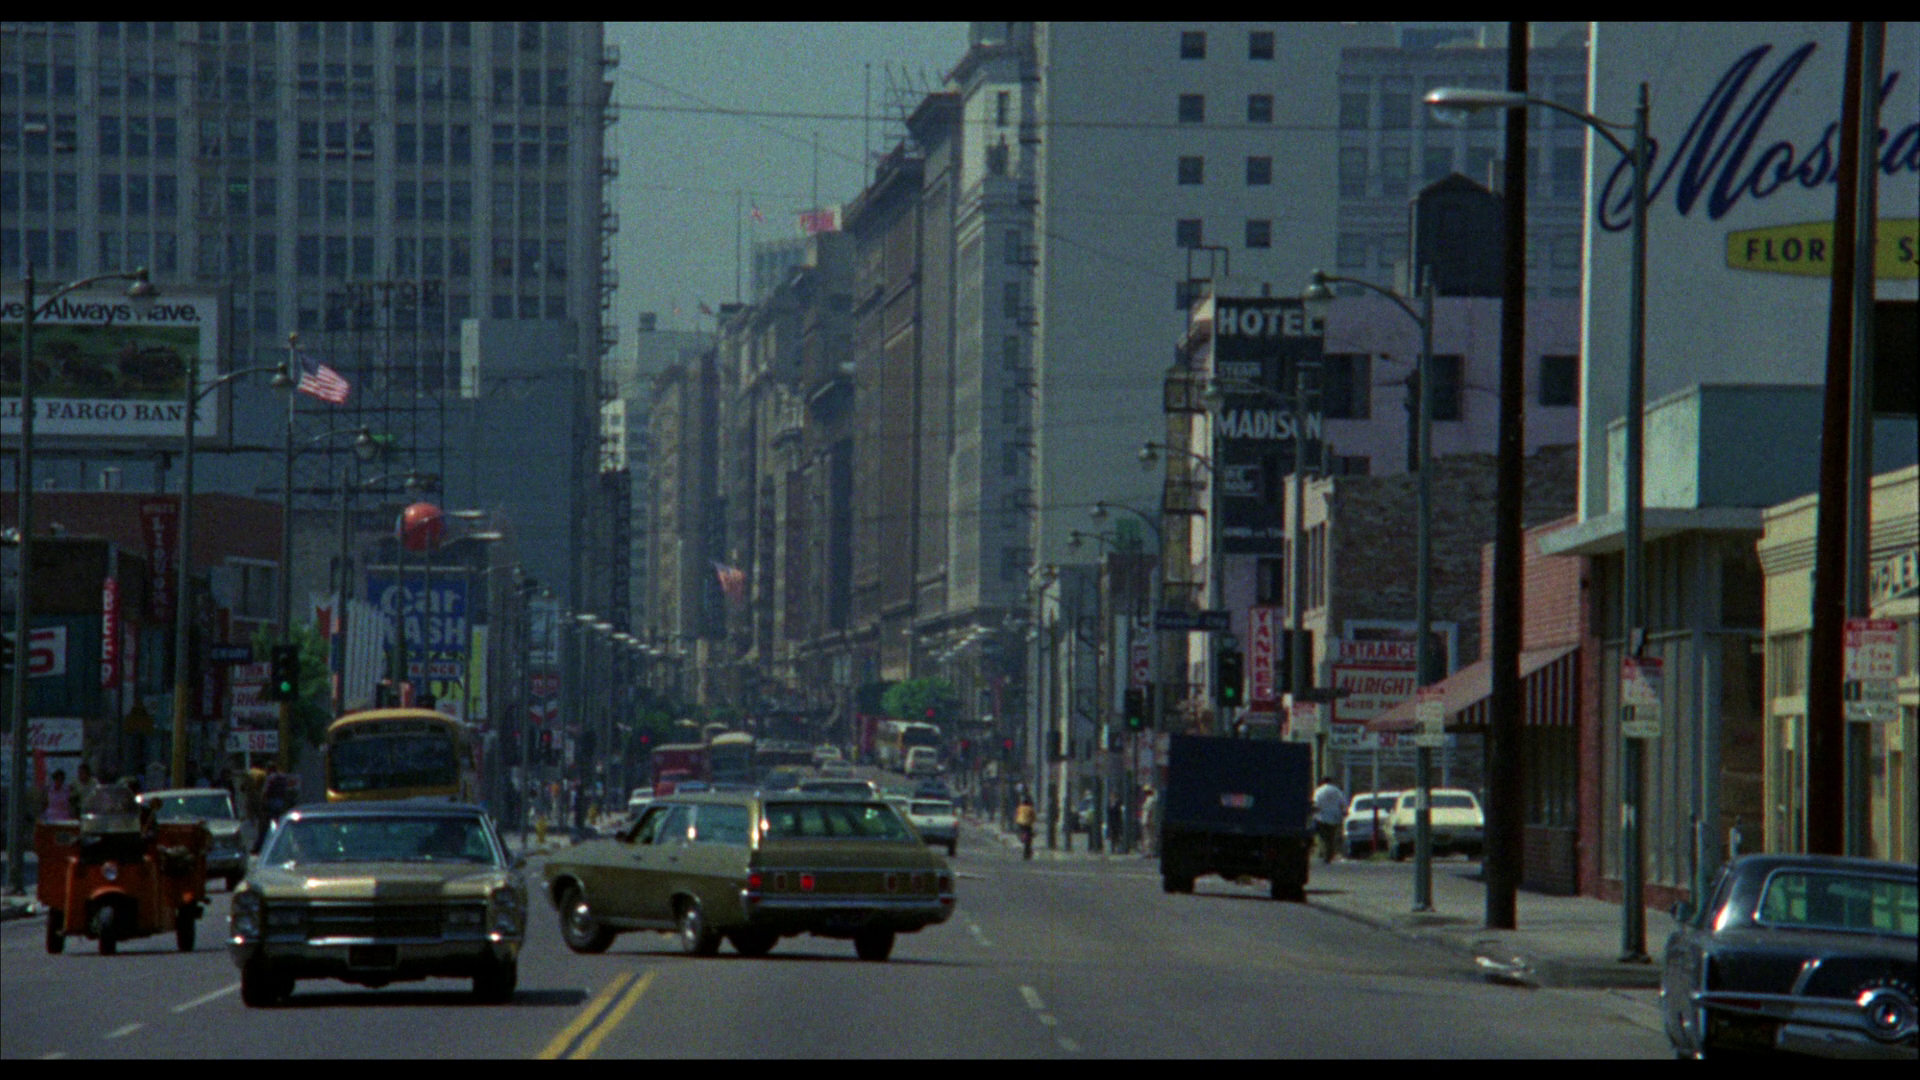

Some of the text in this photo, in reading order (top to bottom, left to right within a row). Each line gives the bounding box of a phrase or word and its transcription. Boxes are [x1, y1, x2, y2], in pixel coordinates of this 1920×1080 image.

[44, 300, 131, 326] Always
[1216, 307, 1323, 336] HOTEL
[46, 403, 127, 421] FARGO
[379, 584, 462, 617] Car
[1339, 641, 1416, 659] ENTRANCE
[1341, 676, 1415, 696] ALLRIGHT
